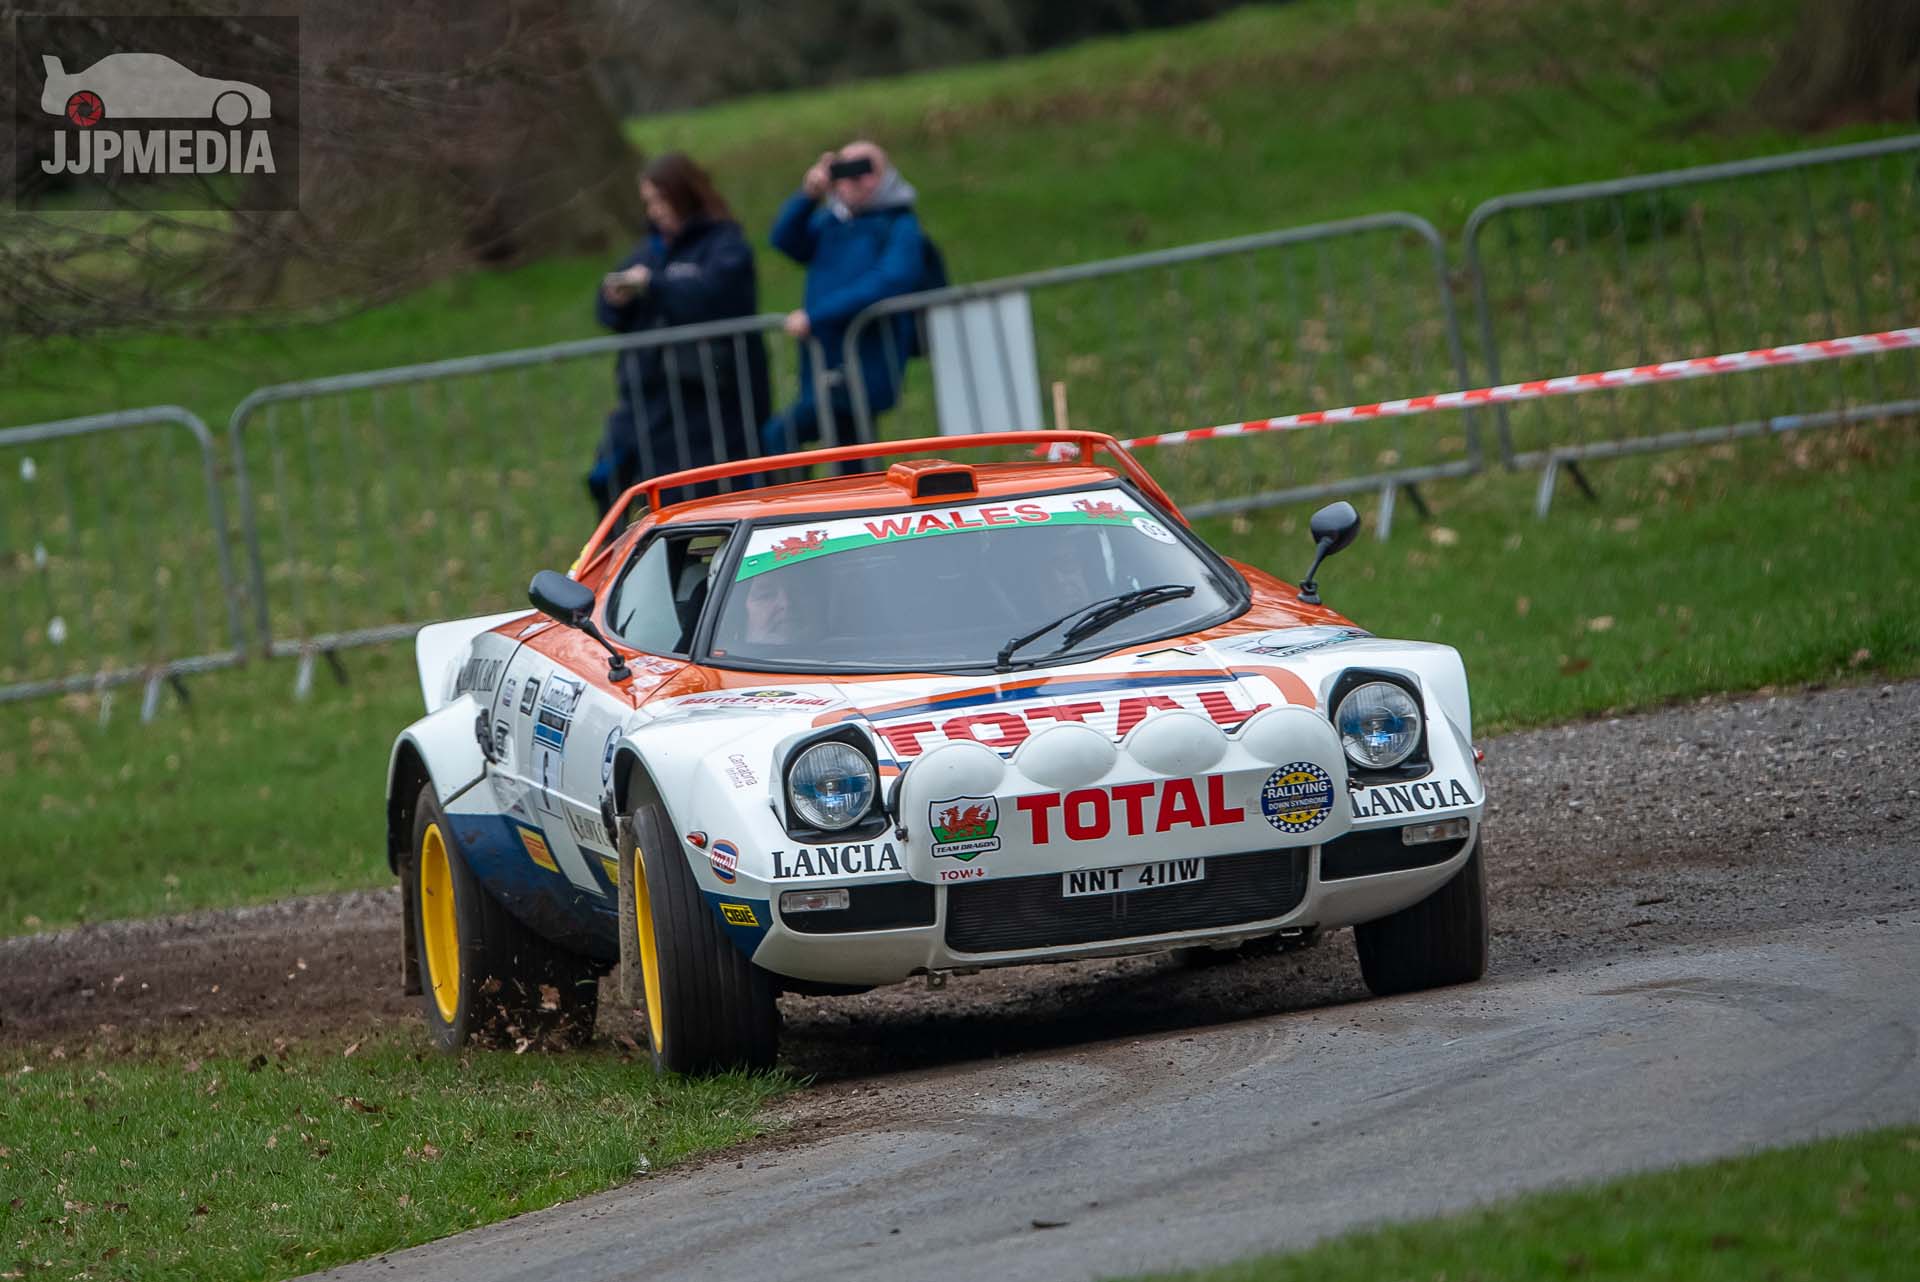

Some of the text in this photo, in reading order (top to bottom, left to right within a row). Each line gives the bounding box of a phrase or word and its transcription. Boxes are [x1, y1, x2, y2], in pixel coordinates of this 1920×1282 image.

[865, 503, 1051, 539] WALES
[1267, 781, 1328, 799] RALLYING
[1268, 800, 1290, 811] DOWN
[1291, 795, 1329, 807] SYNDROME
[1350, 779, 1475, 818] LANCIA
[1016, 774, 1245, 844] TOTAL
[771, 843, 902, 879] LANCIA
[936, 840, 996, 853] TEAM DRAGON
[940, 868, 974, 880] TOW
[1069, 858, 1200, 894] NNT 411W
